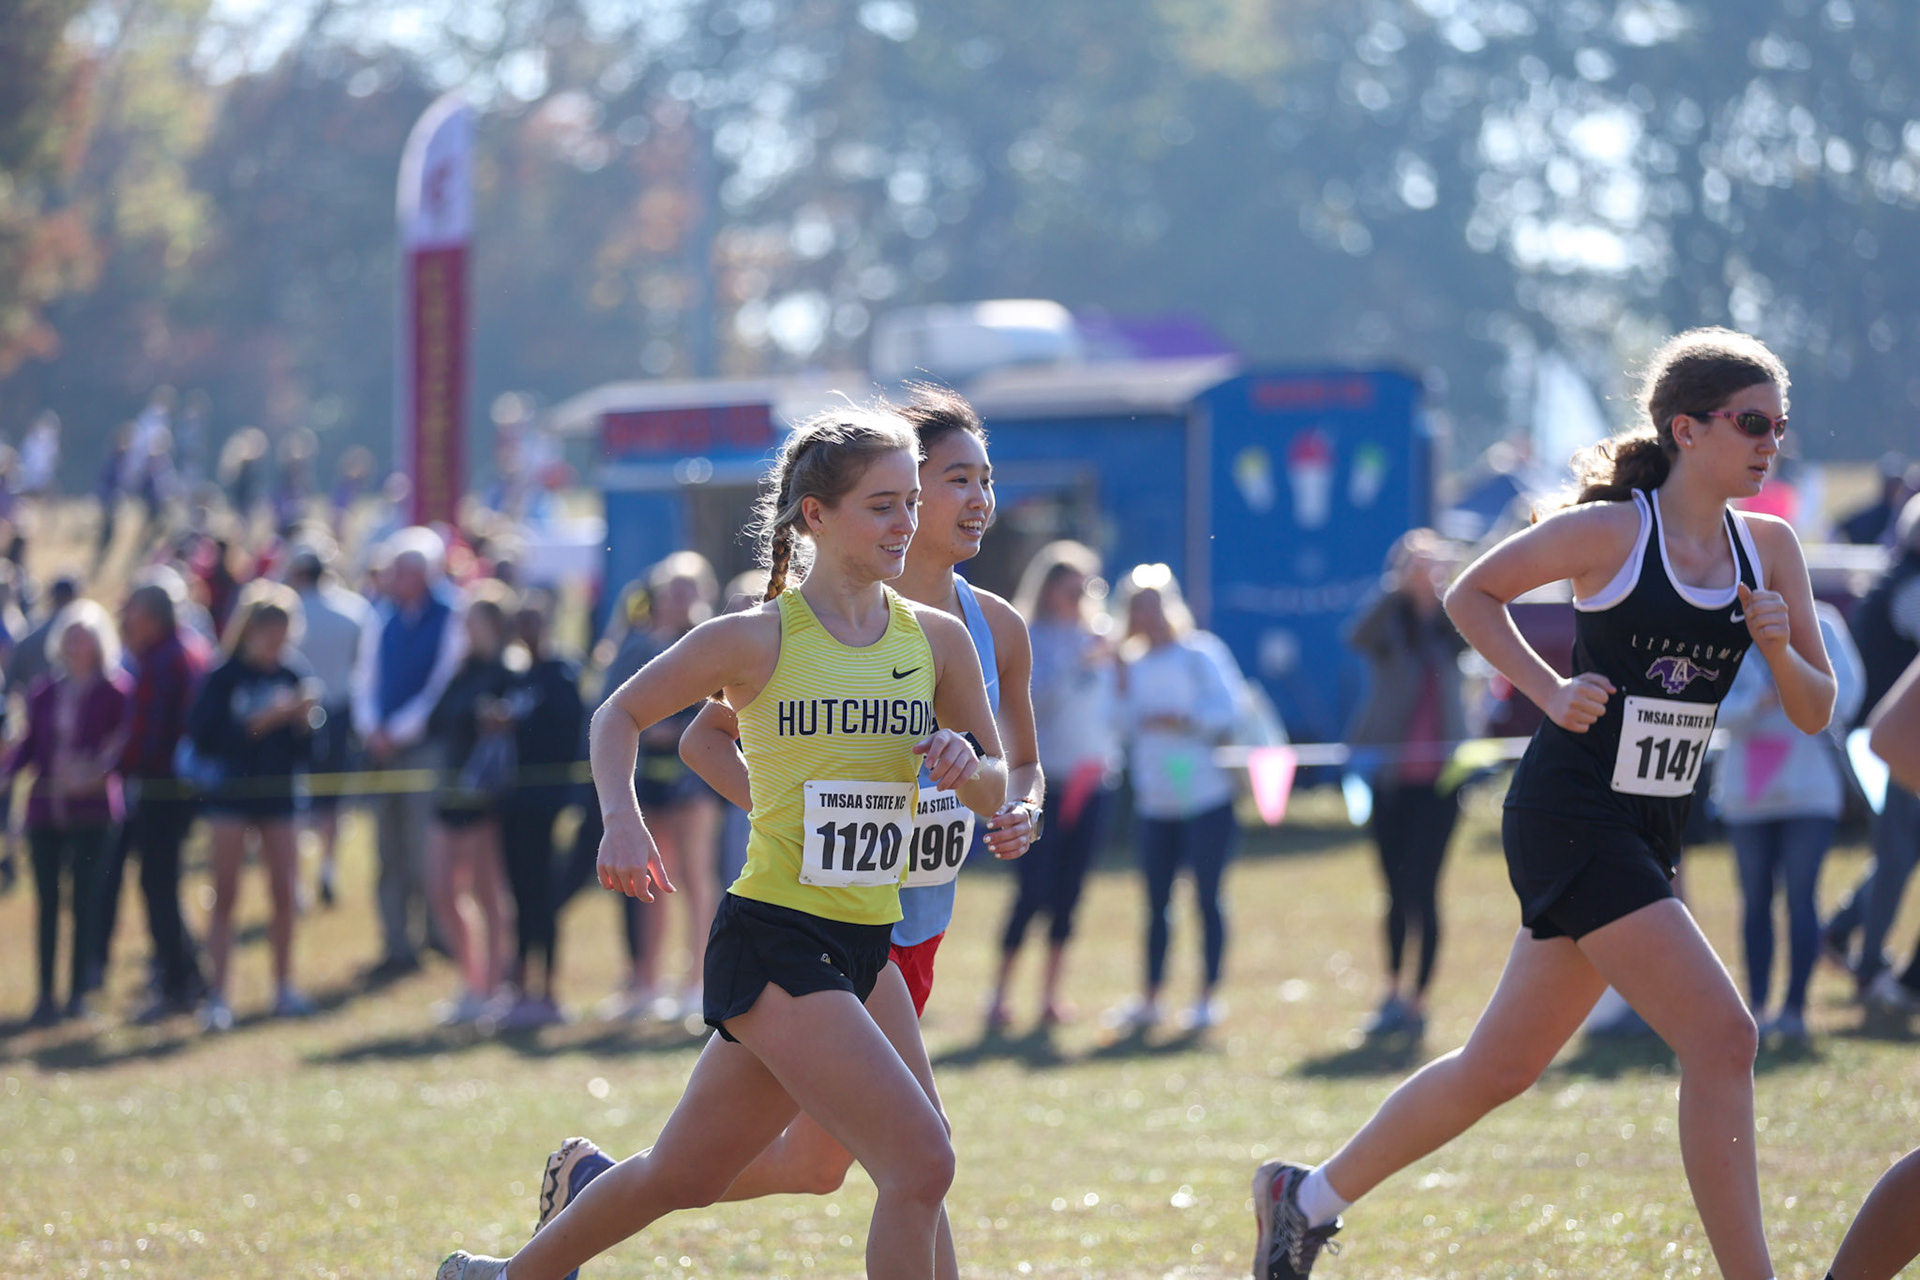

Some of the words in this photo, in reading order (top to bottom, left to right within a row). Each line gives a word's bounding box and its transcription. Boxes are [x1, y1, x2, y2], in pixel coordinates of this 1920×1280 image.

[778, 698, 932, 737] HUTCHISON
[1637, 709, 1674, 727] TMSAA
[1676, 713, 1703, 729] STATE
[1635, 735, 1704, 783] 1141
[819, 793, 863, 809] TMSAA
[865, 794, 894, 810] STATE
[894, 795, 906, 810] XC
[929, 796, 955, 814] STATE
[816, 821, 903, 872] 1120
